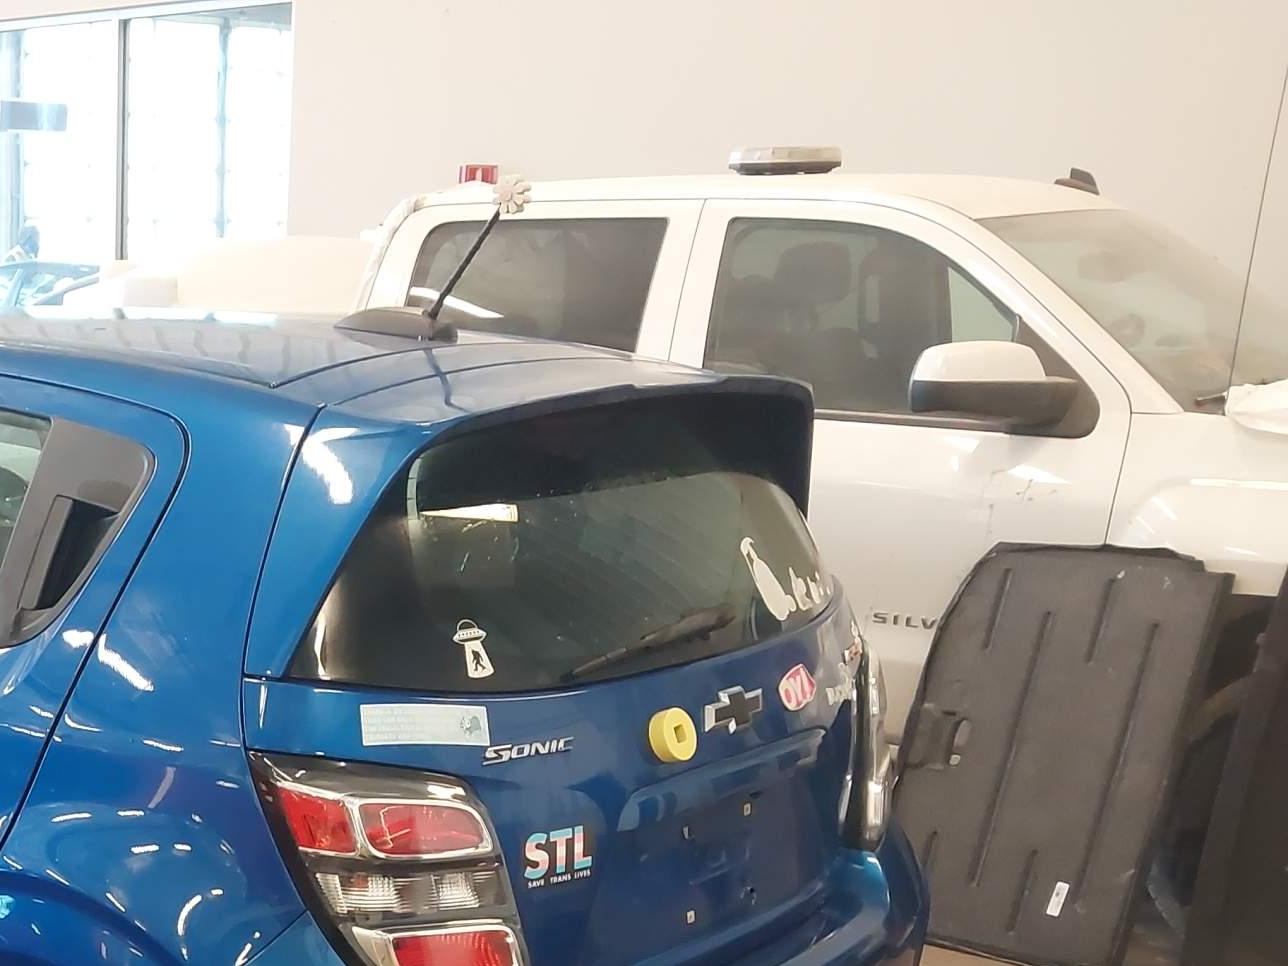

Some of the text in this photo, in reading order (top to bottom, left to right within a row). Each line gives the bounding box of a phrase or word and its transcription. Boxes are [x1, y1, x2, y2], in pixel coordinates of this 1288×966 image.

[482, 736, 575, 766] SONIC
[524, 825, 593, 879] STL
[527, 869, 591, 889] SAVE TRANS LIVES
